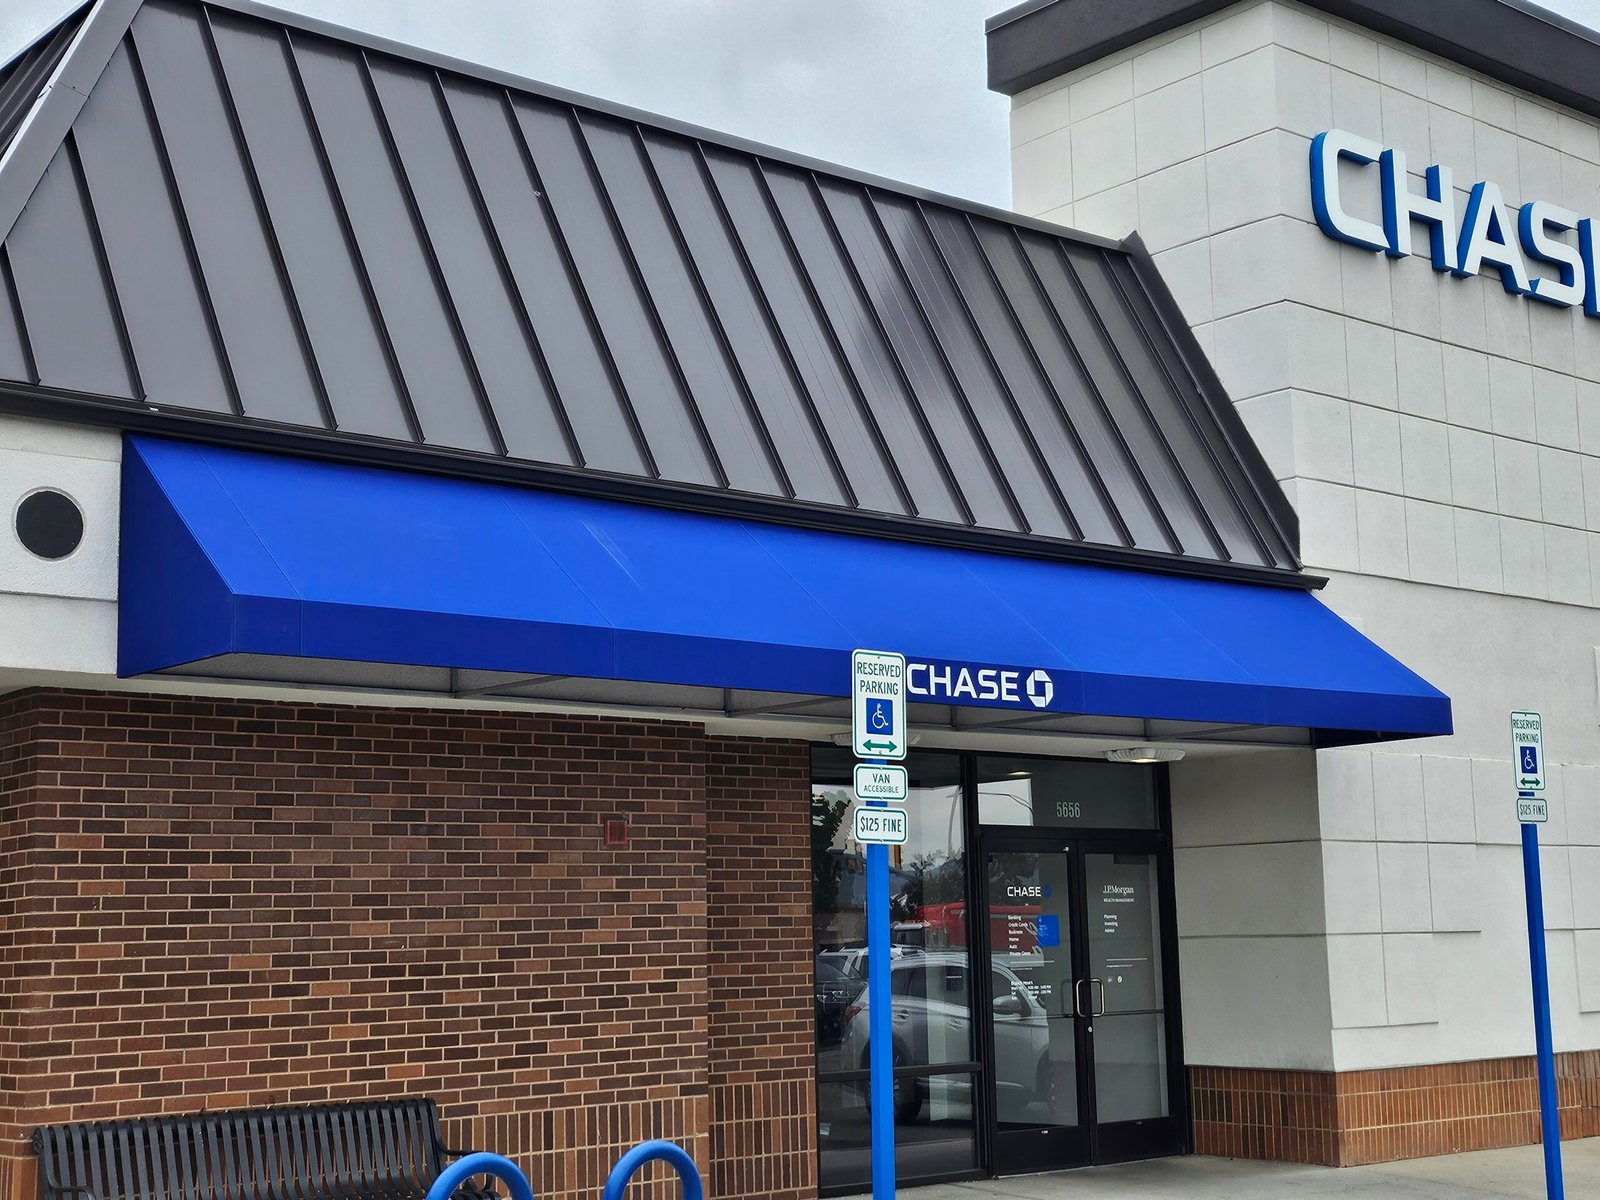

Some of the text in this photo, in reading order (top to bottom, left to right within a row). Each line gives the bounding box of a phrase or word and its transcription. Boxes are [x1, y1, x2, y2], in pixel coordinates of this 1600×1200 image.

[857, 661, 901, 678] RESERVED
[859, 680, 899, 695] PARKING
[906, 663, 1021, 702] CHASE
[1512, 719, 1540, 730] RESERVED
[1515, 733, 1539, 743] PARKING
[872, 773, 891, 784] VAN
[863, 785, 899, 794] ACCESSIBLE
[1056, 801, 1081, 818] 5656
[1519, 804, 1545, 816] $125 FINE
[860, 817, 902, 833] $125 FINE
[1007, 886, 1042, 897] CHASE
